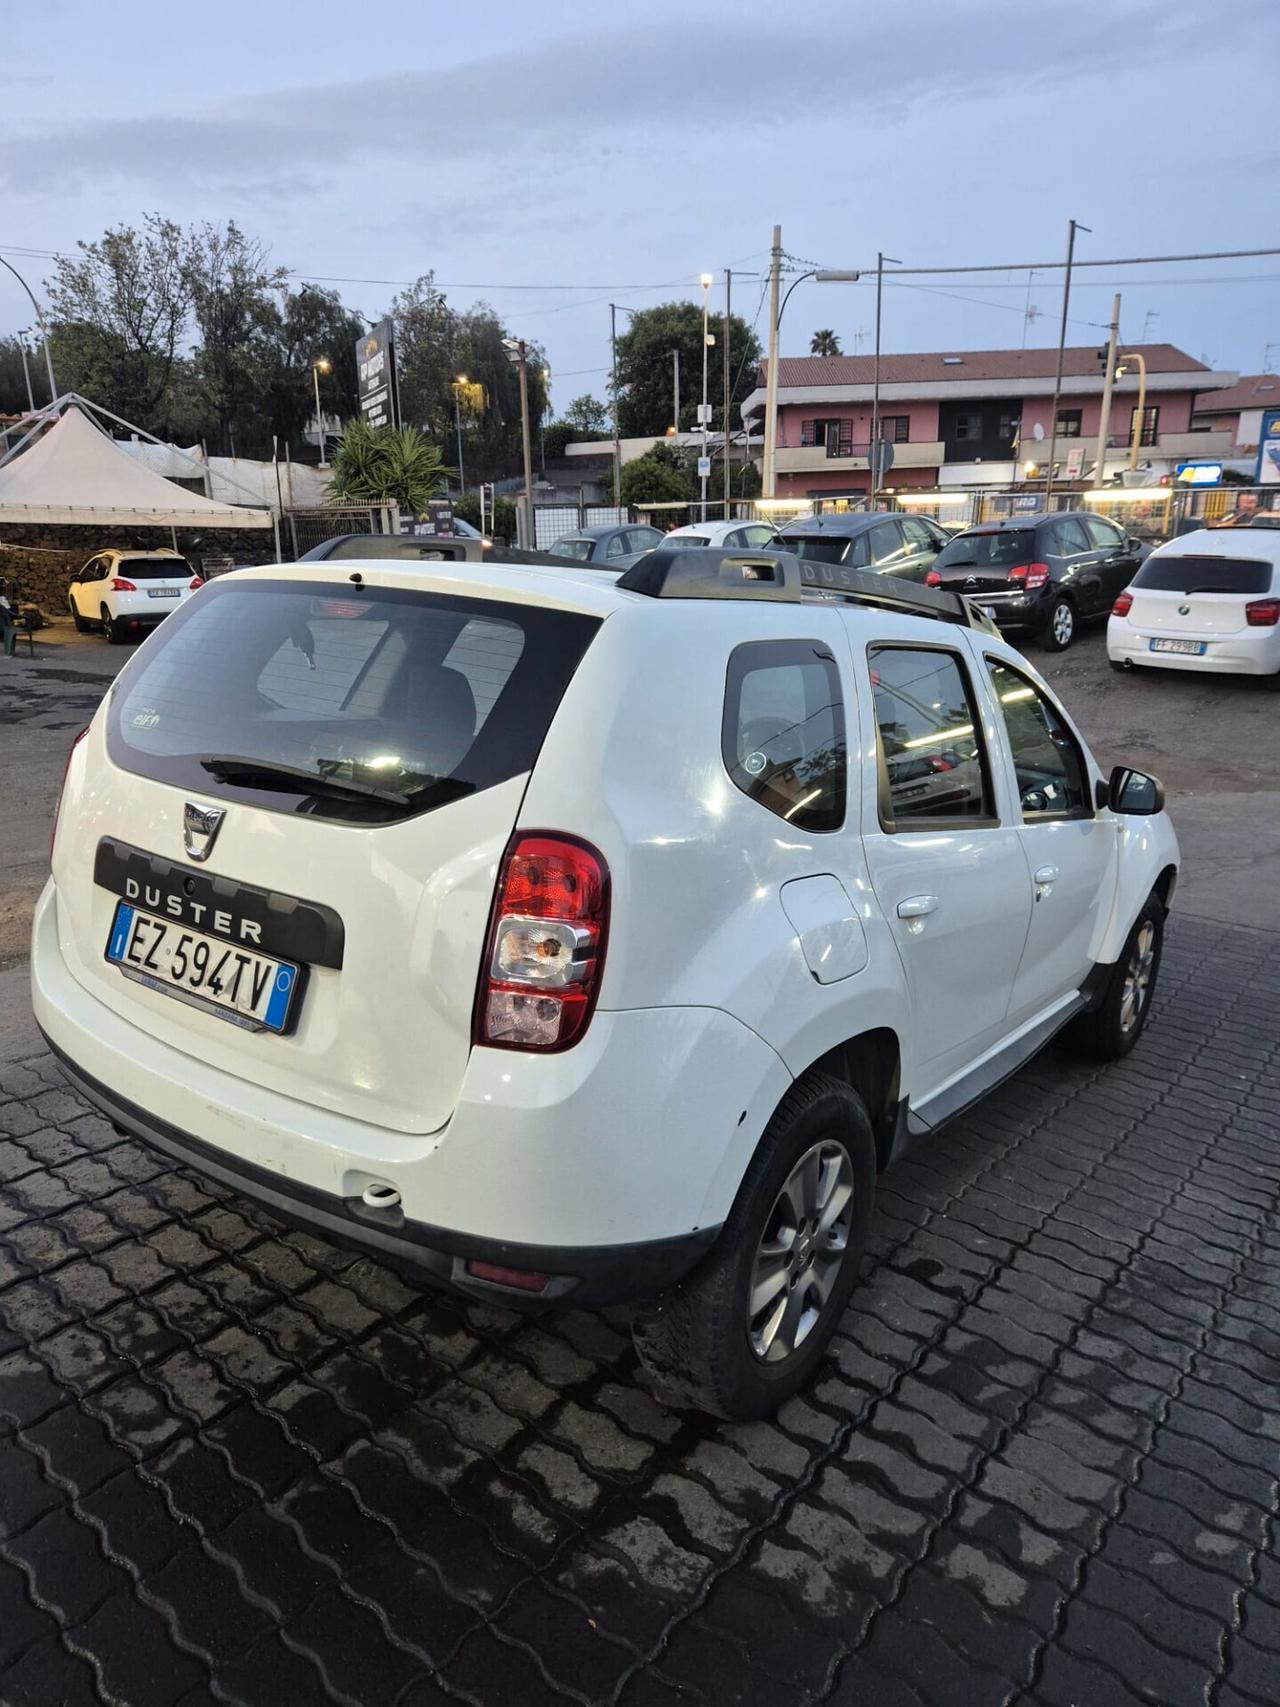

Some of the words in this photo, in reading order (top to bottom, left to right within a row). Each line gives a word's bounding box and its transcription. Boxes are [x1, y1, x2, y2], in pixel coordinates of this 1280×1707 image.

[803, 565, 898, 592] DUSTER
[126, 878, 262, 943] DUSTER
[127, 916, 167, 970] EZ
[171, 935, 272, 1011] 594TV
